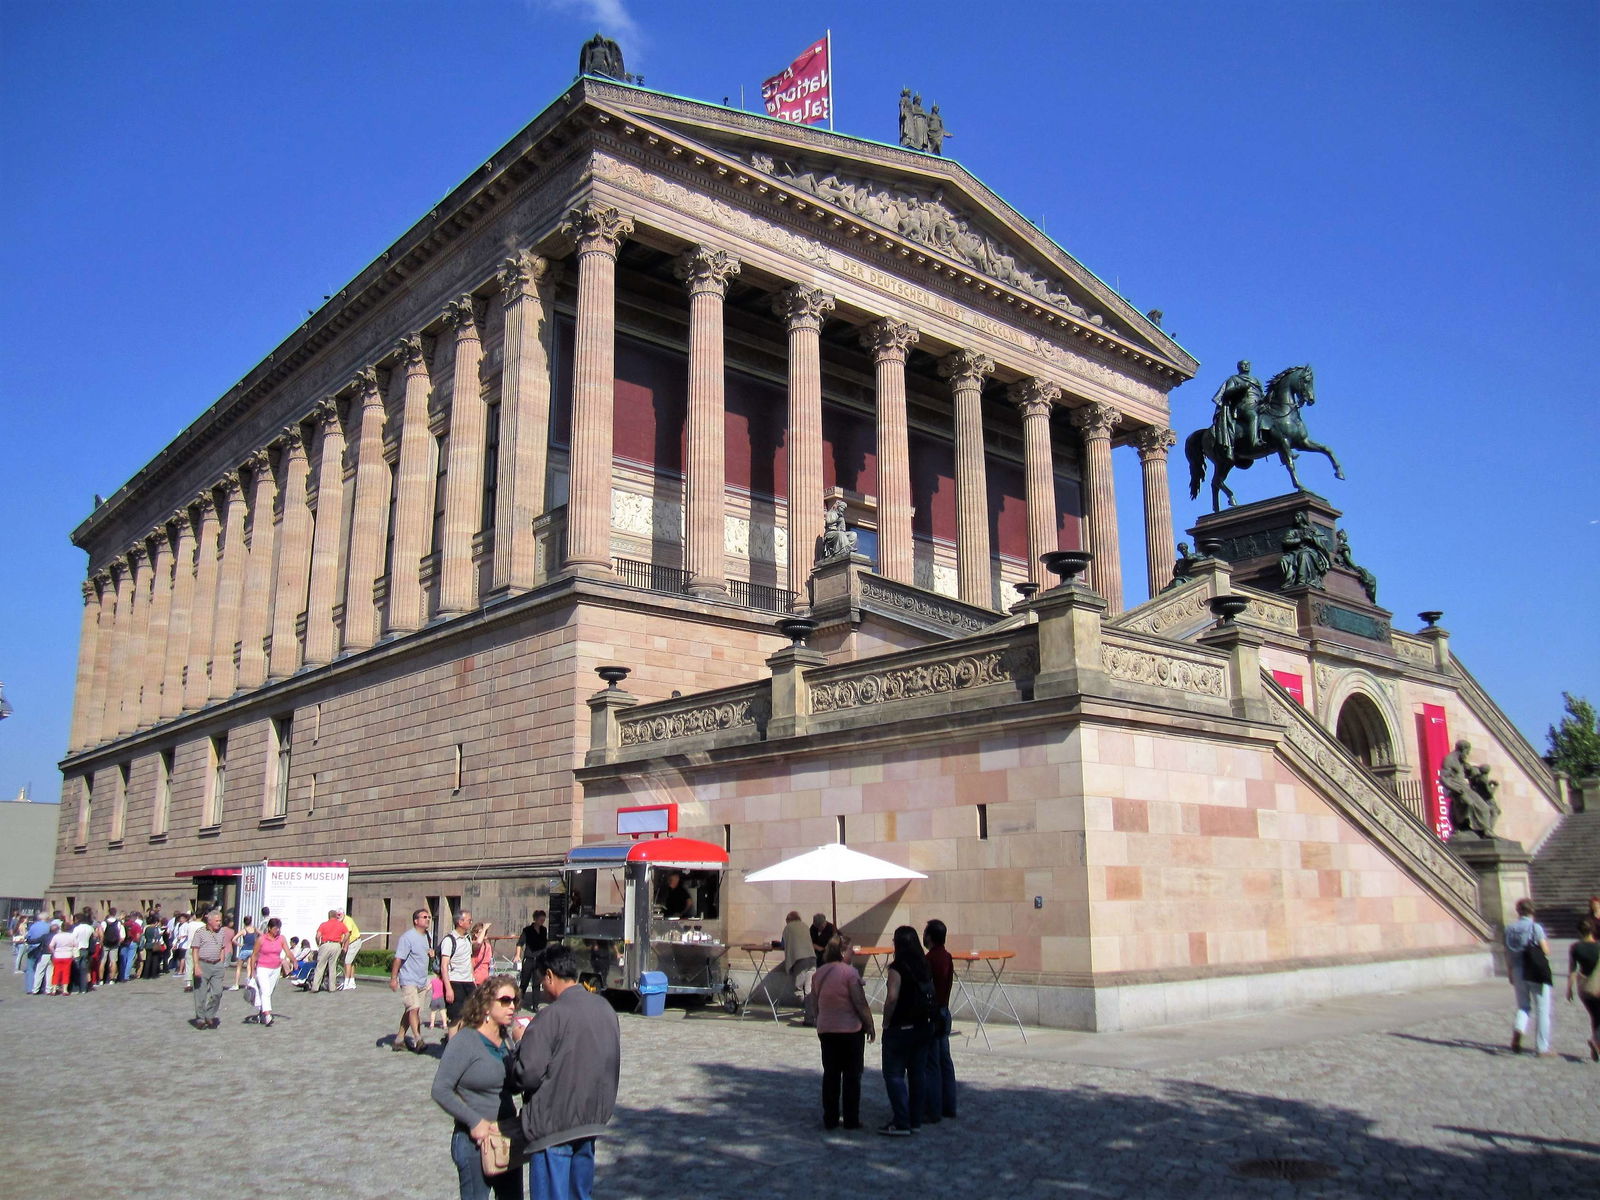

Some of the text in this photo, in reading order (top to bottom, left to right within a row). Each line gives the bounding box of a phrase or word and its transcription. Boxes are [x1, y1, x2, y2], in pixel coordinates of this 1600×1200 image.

[842, 260, 865, 279] DER
[870, 271, 931, 306] DEUTSCHEN
[934, 298, 966, 321] KUNST
[271, 871, 345, 881] NEUES MUSEUM
